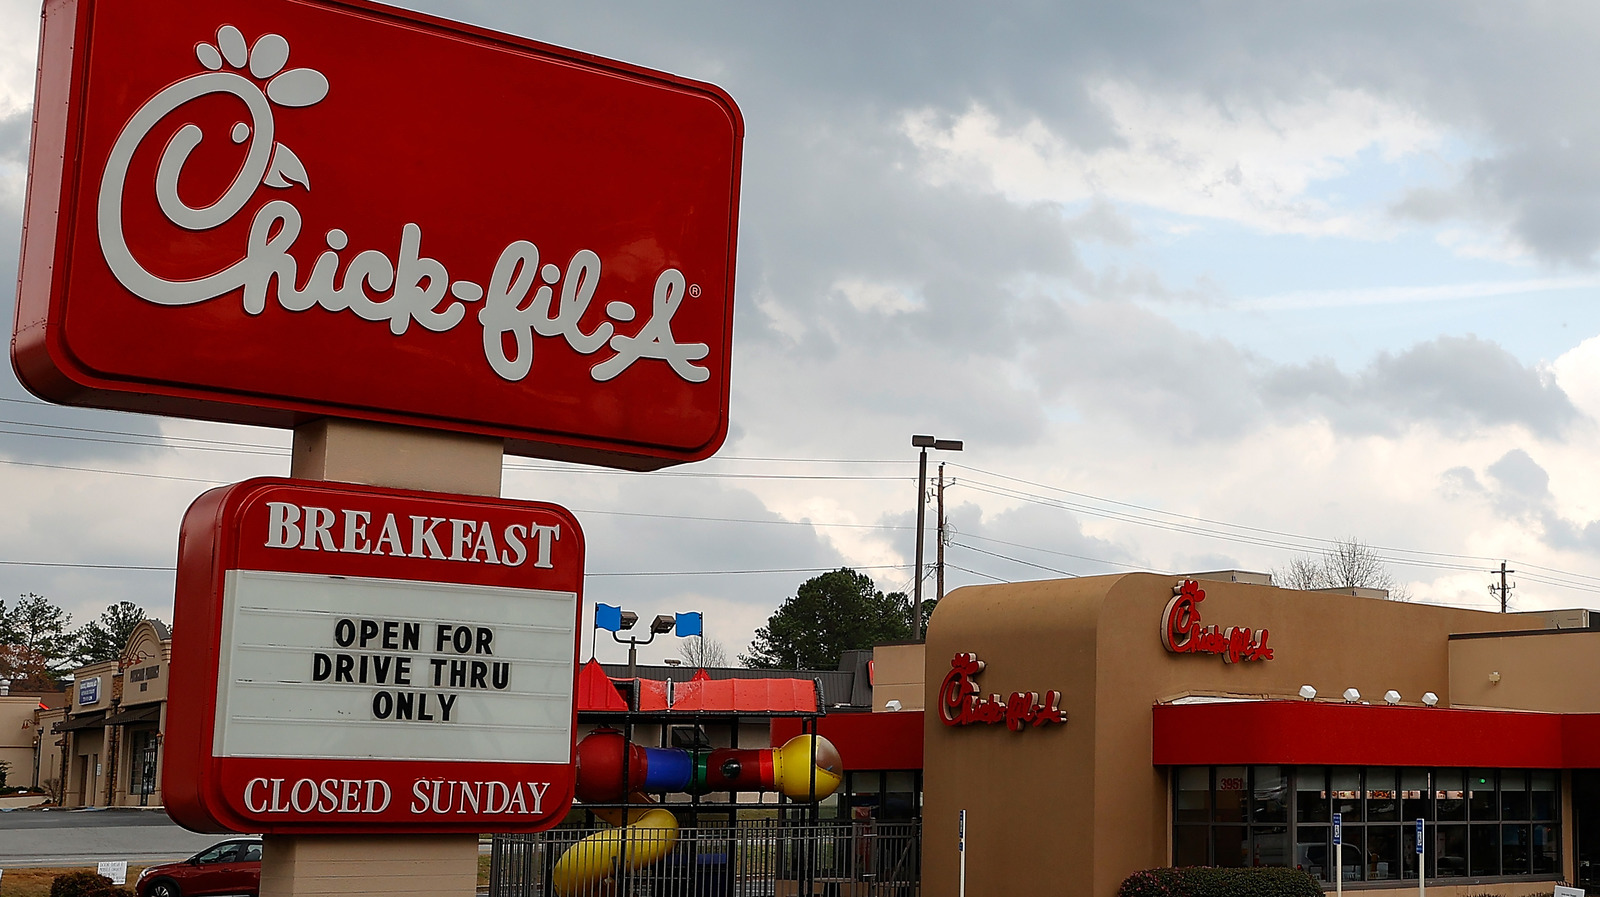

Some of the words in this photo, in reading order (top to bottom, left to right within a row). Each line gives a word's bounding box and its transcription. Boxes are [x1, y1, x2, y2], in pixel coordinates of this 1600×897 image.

[98, 70, 710, 382] Chick-fil-A
[264, 501, 561, 569] BREAKFAST
[334, 618, 421, 651] OPEN
[436, 625, 494, 655] FOR
[312, 653, 412, 686] DRIVE
[430, 658, 511, 690] THRU
[372, 690, 458, 722] ONLY
[244, 778, 392, 814] CLOSED
[410, 779, 551, 815] SUNDAY
[1220, 777, 1244, 790] 3951
